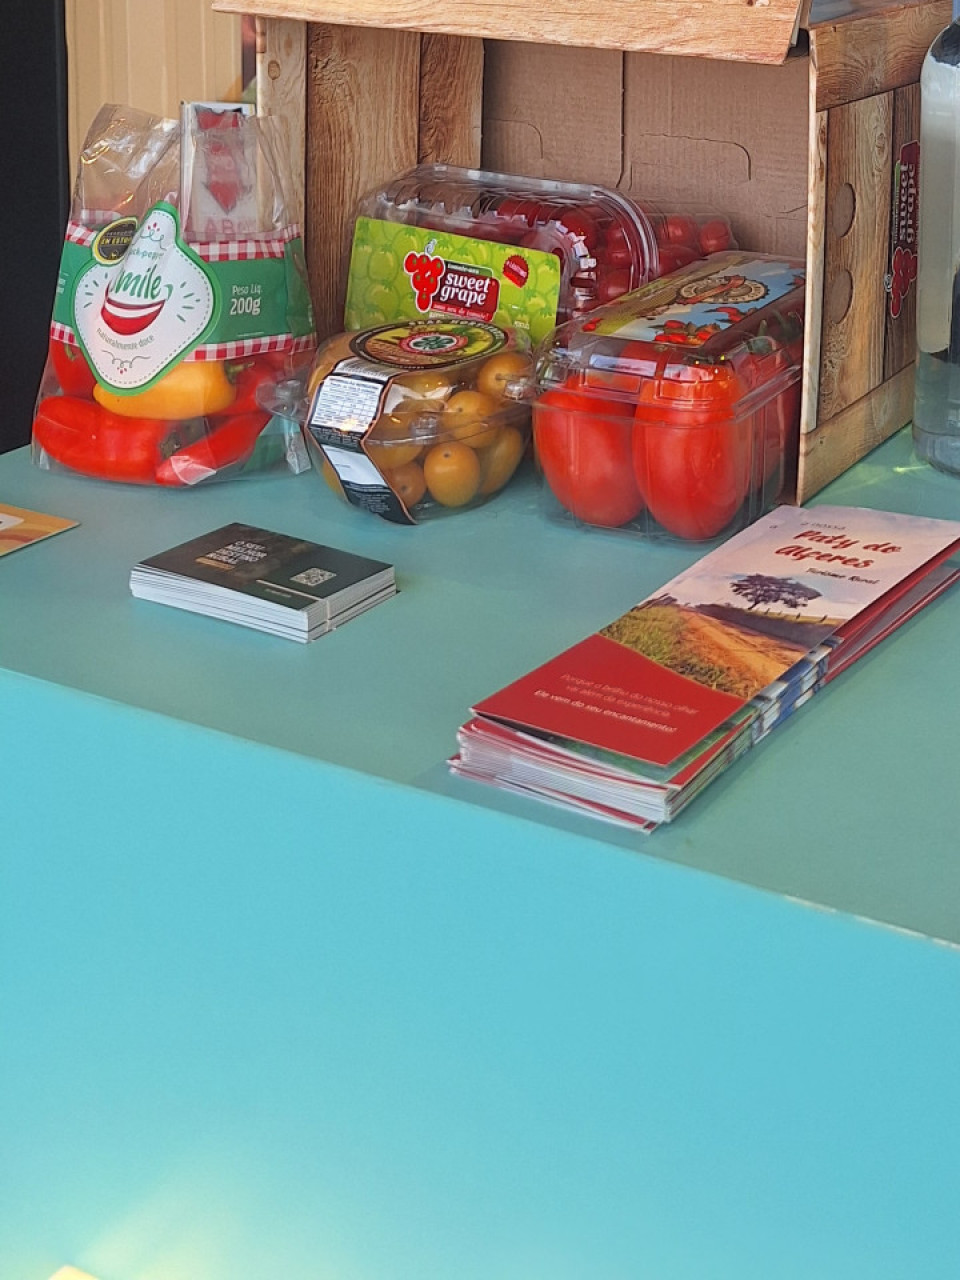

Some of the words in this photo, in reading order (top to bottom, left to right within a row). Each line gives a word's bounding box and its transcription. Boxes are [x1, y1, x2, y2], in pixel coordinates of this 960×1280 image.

[110, 264, 163, 300] mile
[231, 284, 249, 296] Peso
[444, 272, 491, 293] sweet
[229, 296, 262, 316] 200g
[439, 285, 487, 308] grape
[793, 529, 860, 550] Paty
[862, 541, 902, 554] do
[774, 544, 875, 569] Alferes
